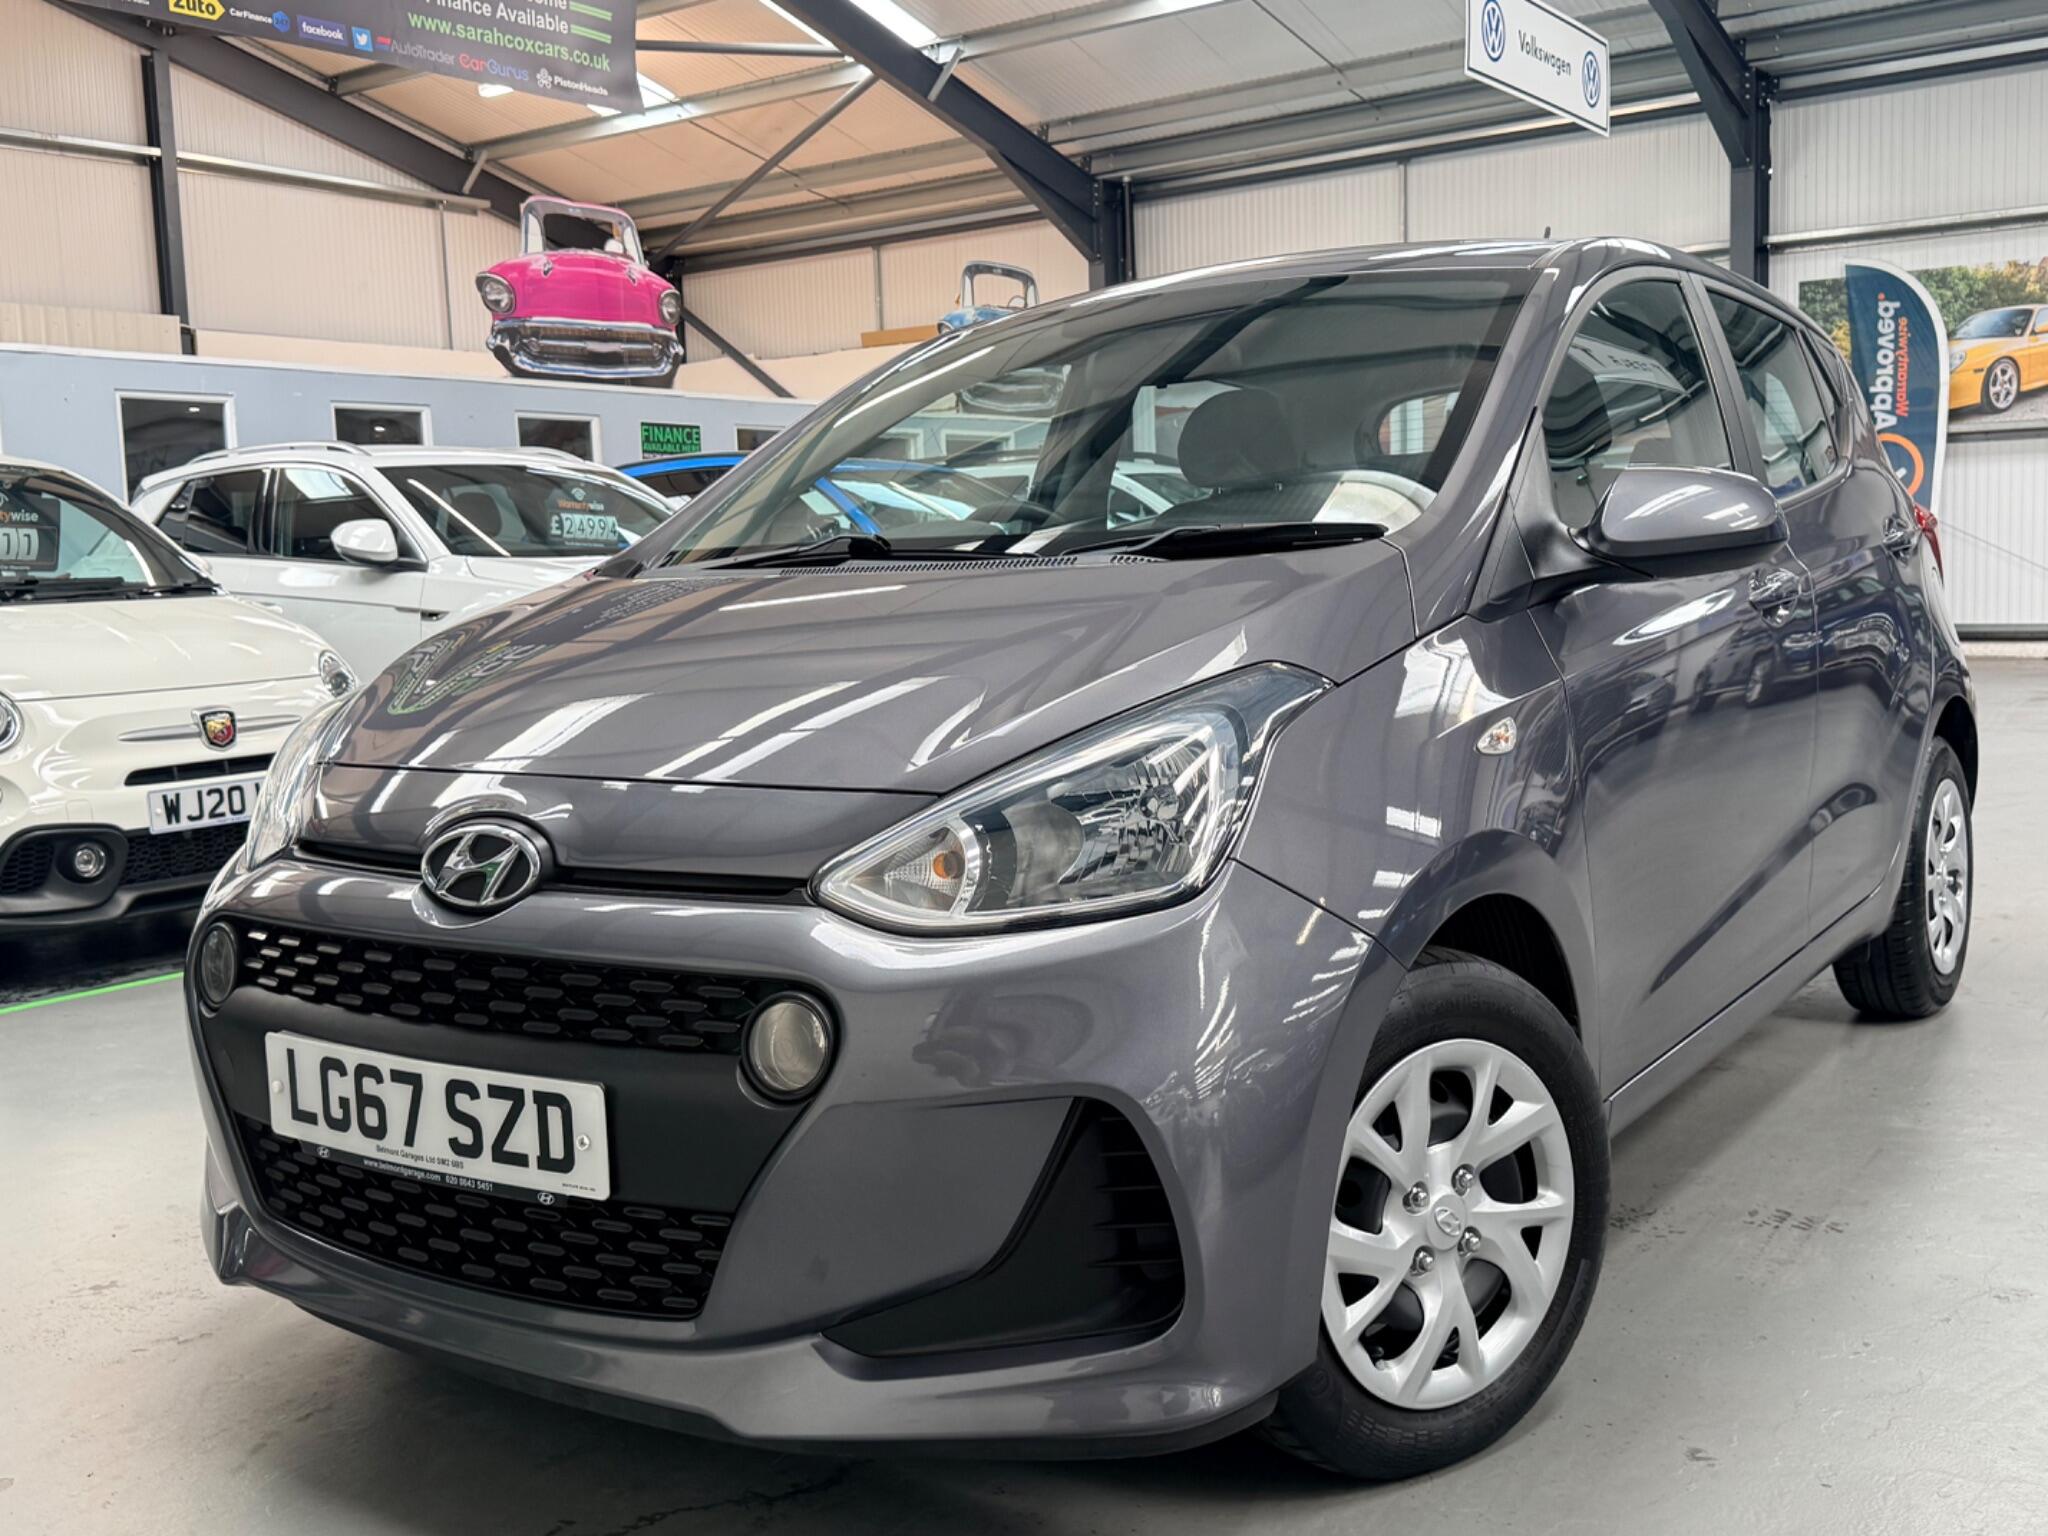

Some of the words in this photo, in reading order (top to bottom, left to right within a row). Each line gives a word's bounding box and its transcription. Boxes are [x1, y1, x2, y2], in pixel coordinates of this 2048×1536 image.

[229, 8, 273, 24] CarFinance
[302, 22, 343, 40] facebook
[426, 0, 492, 17] nance
[495, 3, 569, 34] Available
[408, 12, 611, 72] www.sarahcoxcars.co.uk
[1517, 29, 1571, 76] Volkswagen
[459, 53, 529, 81] CarGurus
[554, 75, 609, 96] PistonHeads
[641, 425, 700, 444] FINANCE
[161, 784, 247, 826] WJ20
[286, 1047, 423, 1148] LG67
[444, 1078, 576, 1174] SZD
